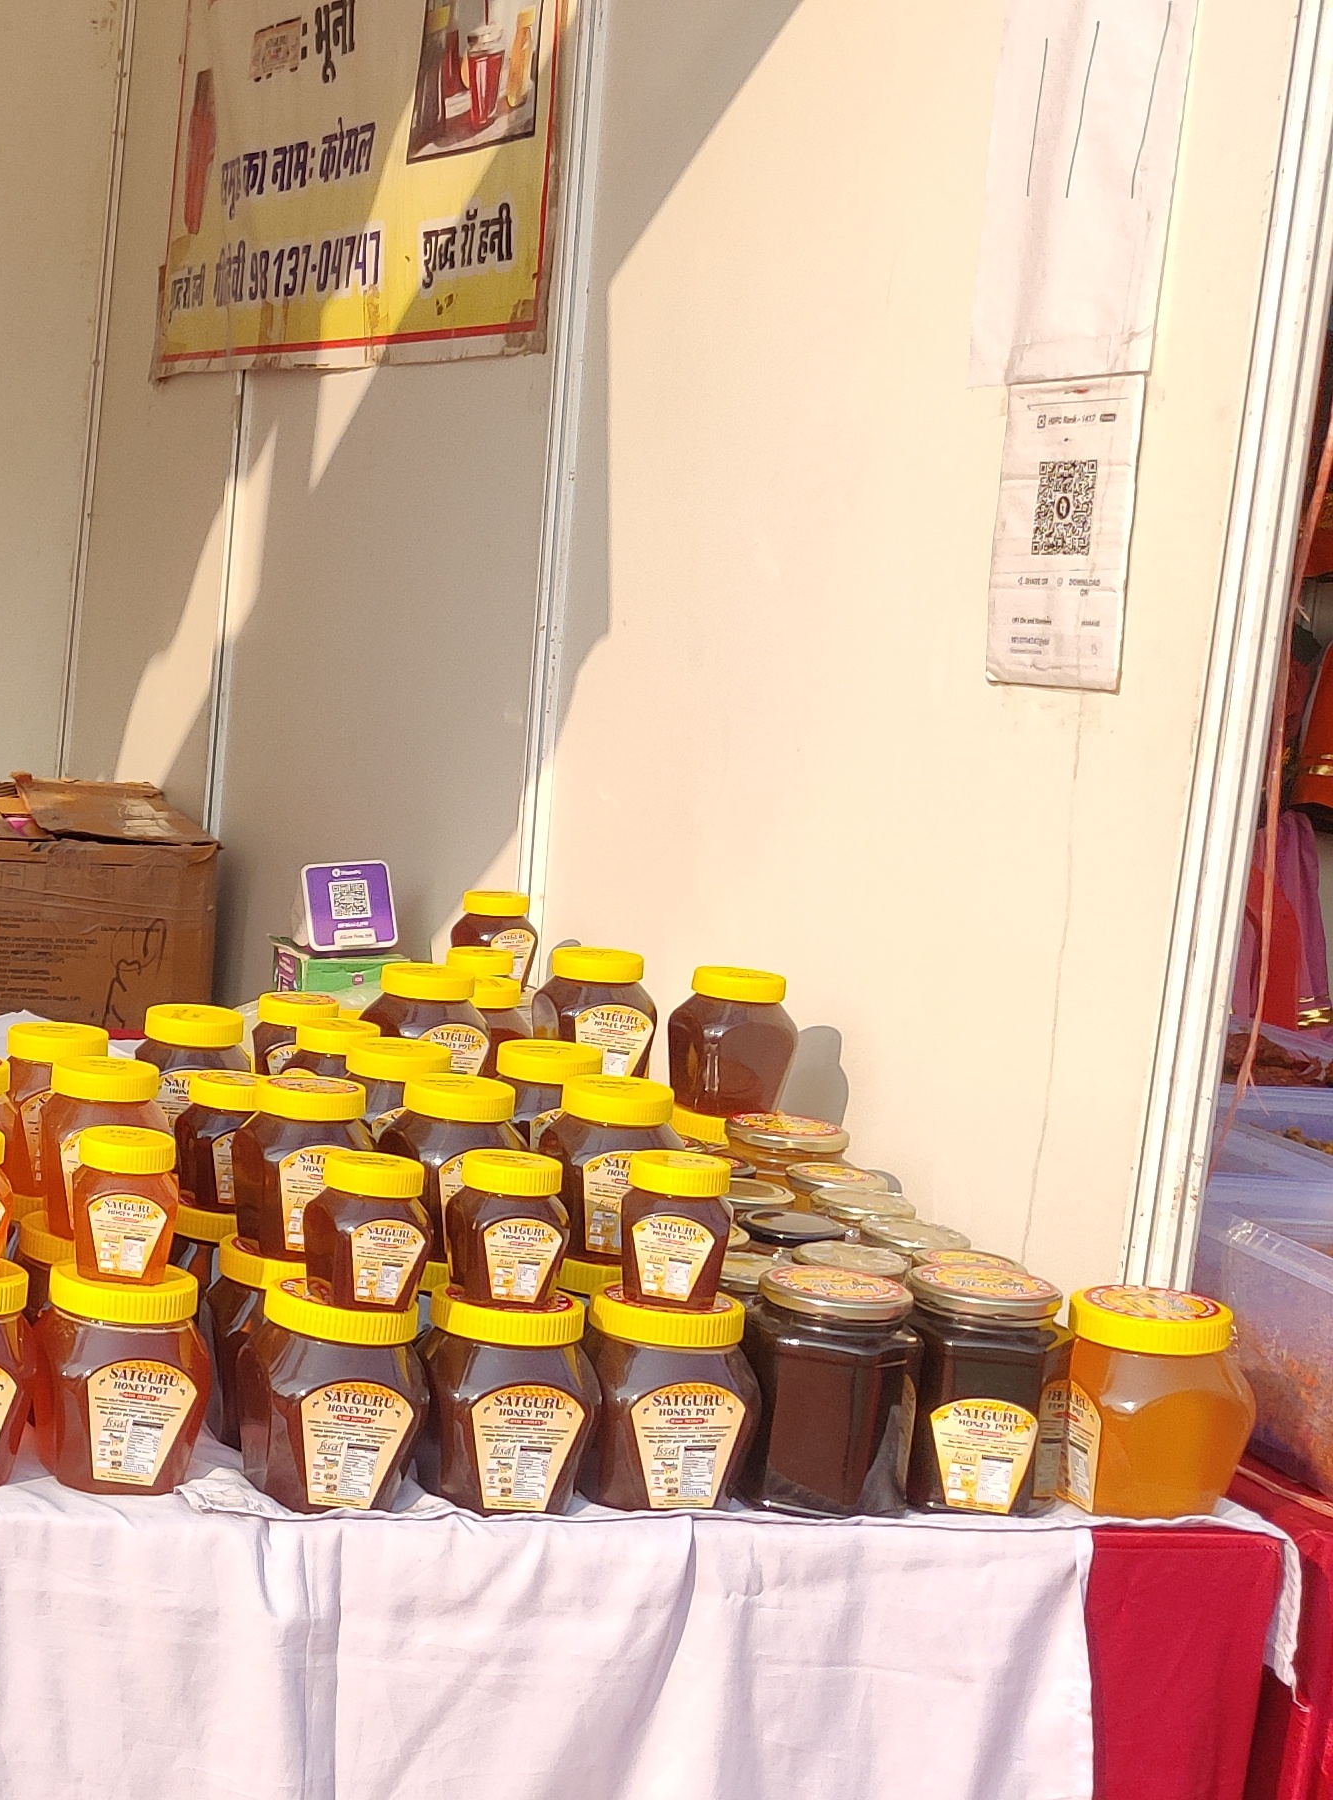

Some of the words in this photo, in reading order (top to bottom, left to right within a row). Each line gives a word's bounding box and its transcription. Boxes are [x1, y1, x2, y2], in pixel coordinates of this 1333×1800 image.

[319, 116, 376, 183] कोमल
[109, 1368, 179, 1386] SATGURU
[113, 1382, 146, 1393] HONEY
[149, 1385, 169, 1395] POT
[323, 1390, 395, 1408] SATGURU
[493, 1394, 566, 1410] SATGURU
[652, 1394, 726, 1406] SATGURU
[328, 1403, 360, 1415] HONEY
[363, 1407, 384, 1418] POT
[498, 1408, 531, 1418] HONEY
[536, 1409, 554, 1419] POT
[659, 1408, 692, 1416] HONEY
[696, 1407, 716, 1416] POT
[953, 1407, 1023, 1425] SATGURU
